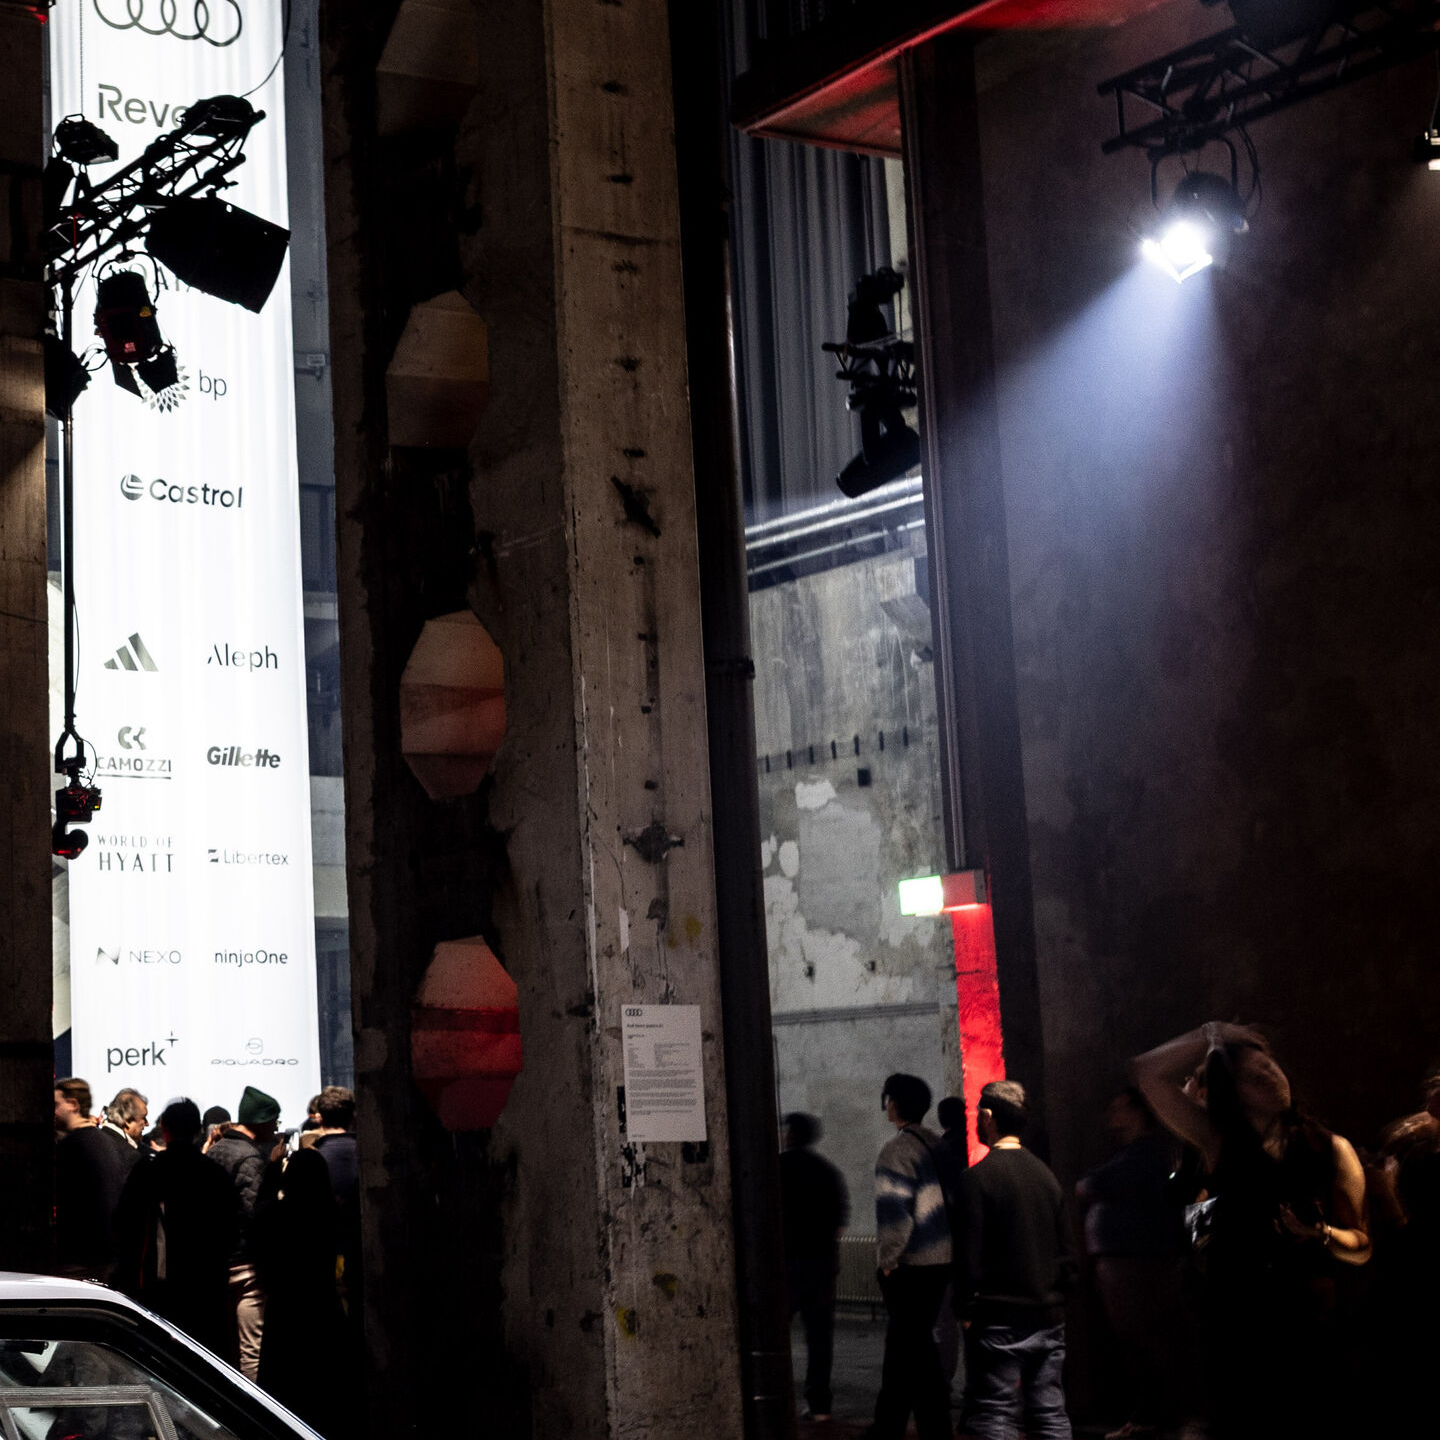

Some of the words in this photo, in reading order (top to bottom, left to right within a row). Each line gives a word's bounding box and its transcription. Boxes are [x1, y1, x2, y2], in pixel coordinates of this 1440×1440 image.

[199, 369, 227, 401] bp
[149, 477, 243, 509] Castrol
[207, 643, 278, 672] Aleph
[97, 756, 172, 772] CAMOZZI
[206, 745, 281, 769] Gillette
[97, 834, 148, 848] WORLD
[98, 851, 174, 873] HYATT
[223, 849, 289, 866] Libertex
[129, 949, 182, 964] NEXO
[214, 949, 288, 968] ninjaOne
